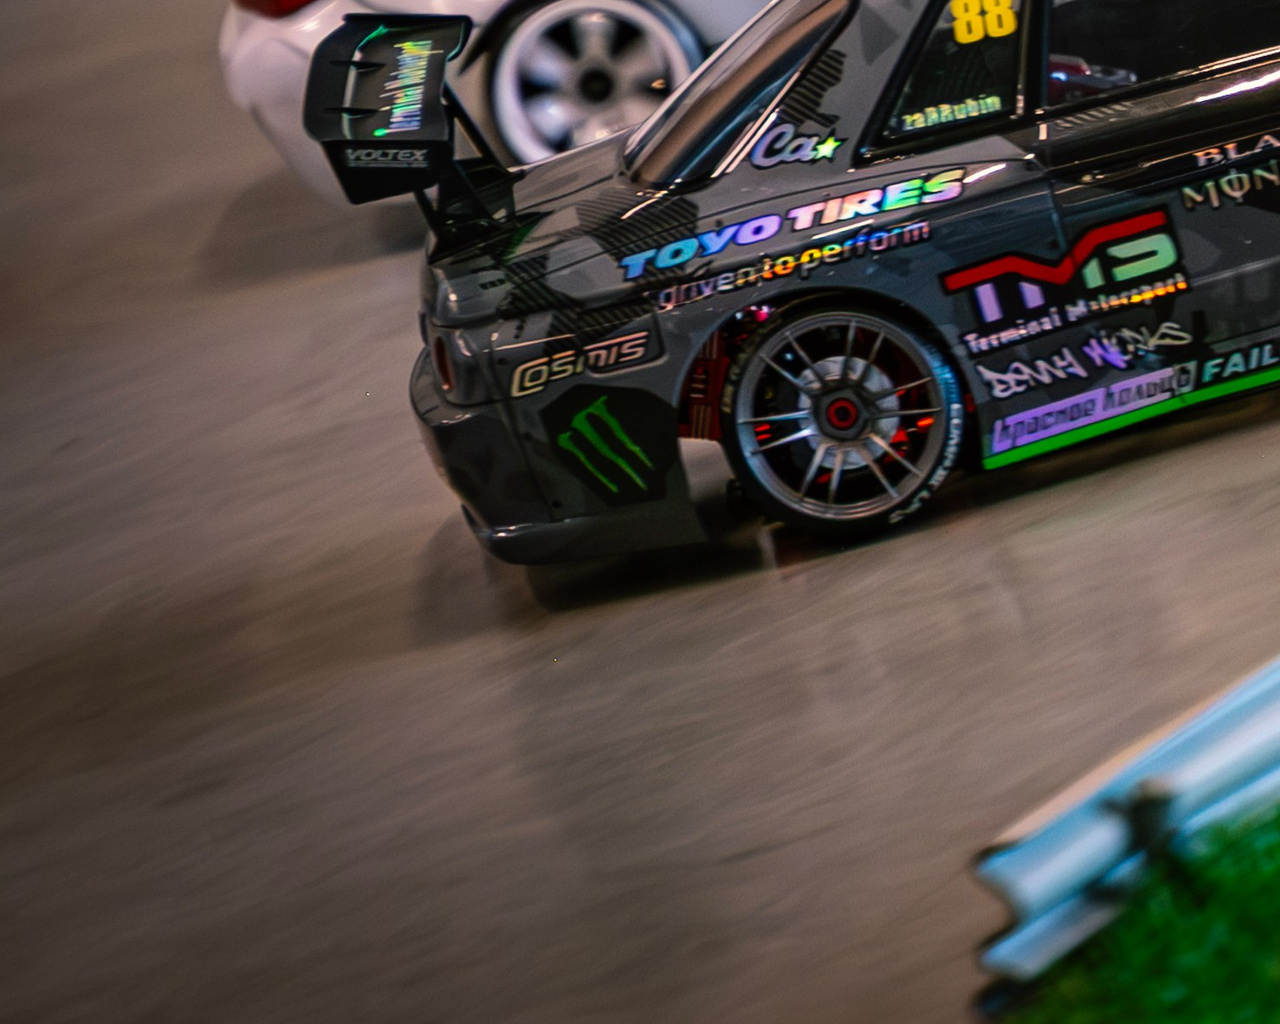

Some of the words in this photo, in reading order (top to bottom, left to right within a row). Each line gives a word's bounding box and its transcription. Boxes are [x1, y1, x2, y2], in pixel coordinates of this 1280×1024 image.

[346, 149, 428, 161] VOLTEX
[620, 215, 782, 280] TOYO
[788, 167, 966, 232] TIRES
[799, 220, 930, 279] perform
[963, 306, 1062, 353] Terminal
